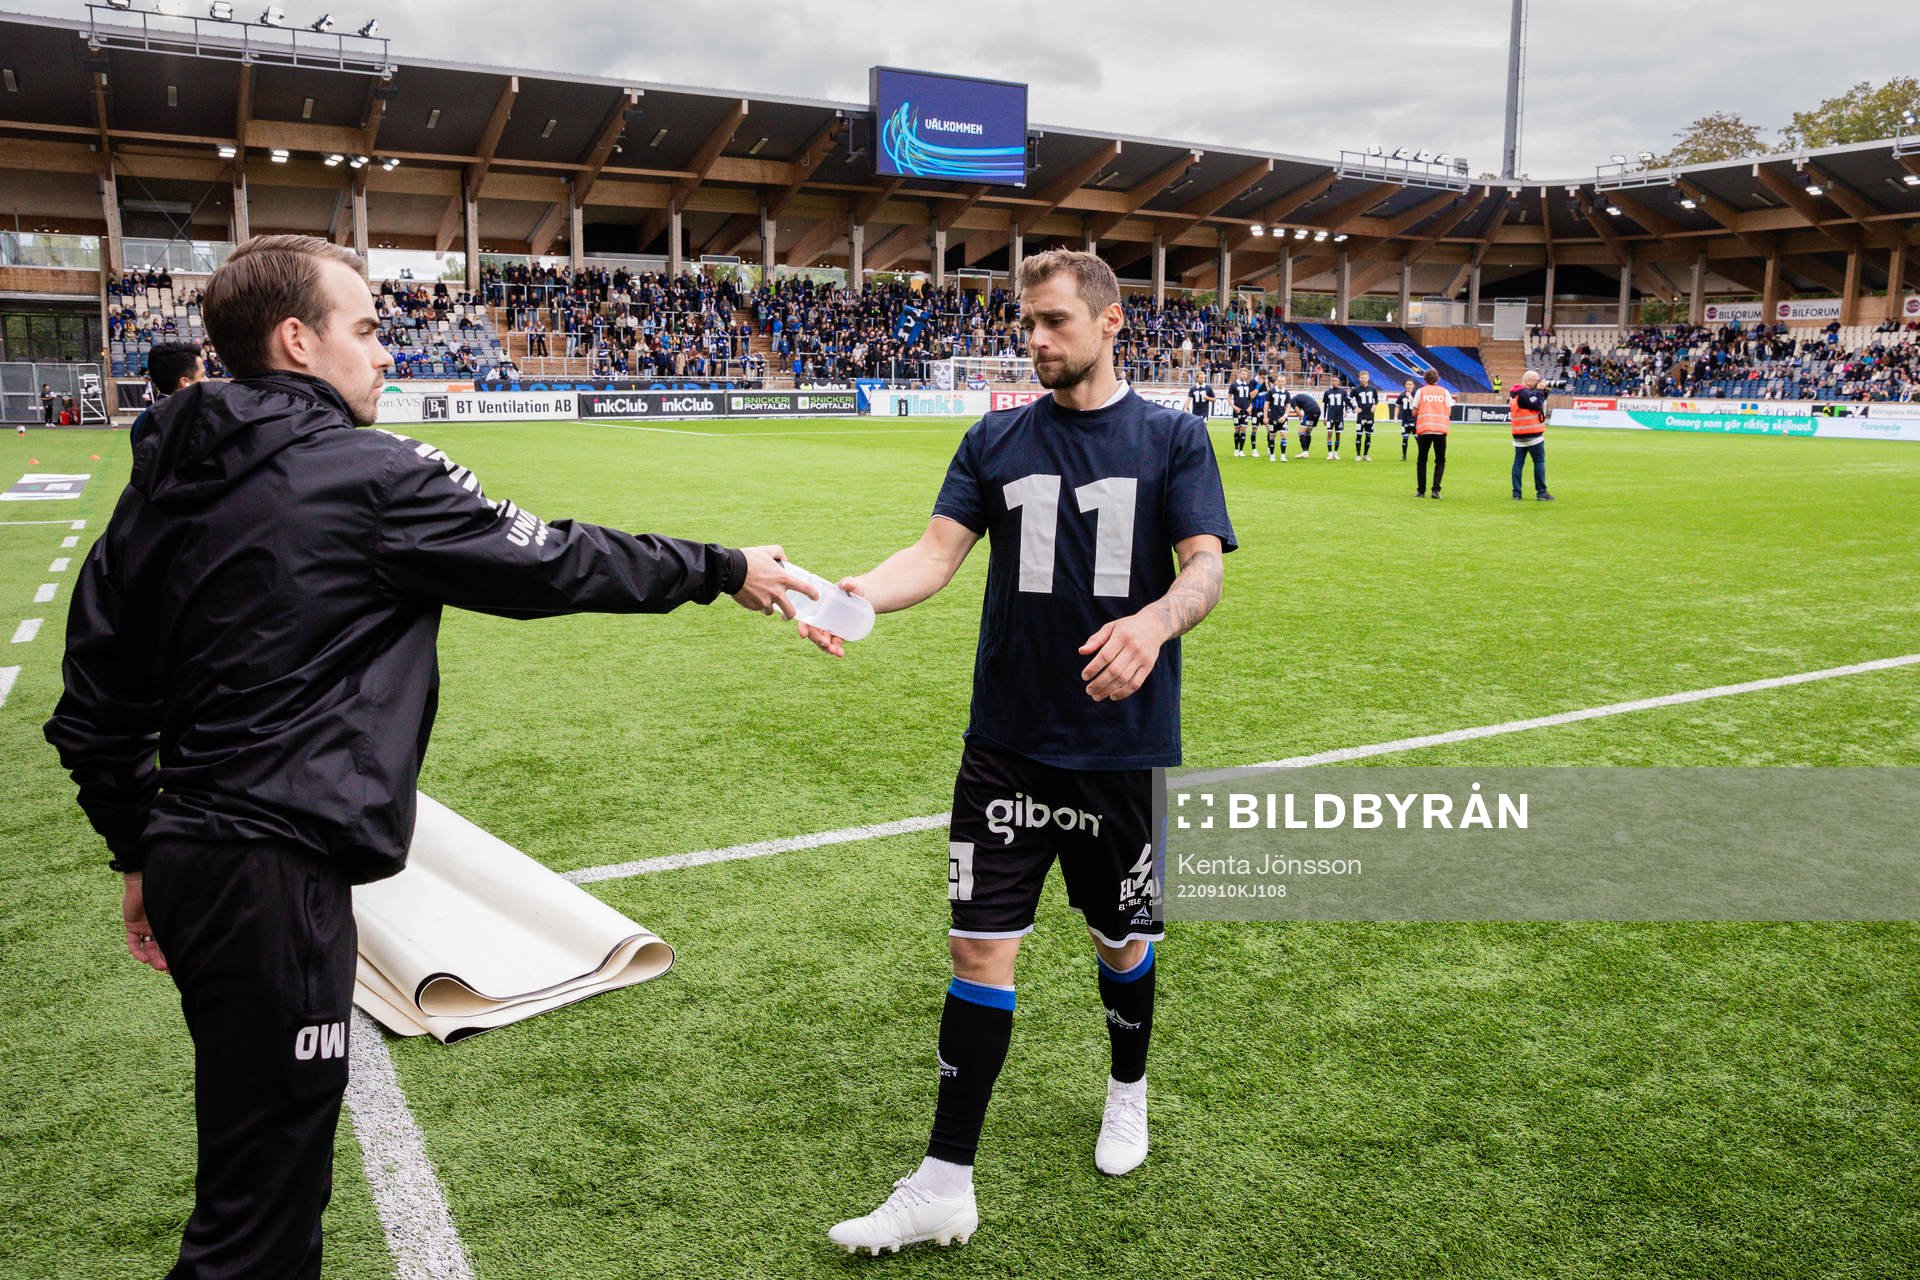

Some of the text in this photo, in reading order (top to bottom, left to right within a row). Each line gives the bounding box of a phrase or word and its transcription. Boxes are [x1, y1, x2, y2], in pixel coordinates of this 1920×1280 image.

[924, 117, 983, 135] VÄLKOMMEN
[1719, 310, 1762, 319] BILFORUM
[1791, 308, 1840, 317] BILFORUM
[1193, 390, 1207, 402] 11
[1237, 386, 1250, 398] 11
[1358, 391, 1374, 404] 11
[593, 398, 648, 413] inkClub
[661, 397, 714, 412] inkClub
[1272, 393, 1286, 406] 11
[1328, 393, 1342, 406] 11
[1423, 395, 1445, 403] FOTO
[456, 399, 572, 414] BT Ventilation AB
[1481, 410, 1508, 422] Railway
[1665, 416, 1700, 429] Omsorg
[1703, 419, 1722, 428] som
[1724, 417, 1741, 431] gör
[1743, 418, 1769, 432] riktig
[1002, 473, 1138, 598] 11
[985, 792, 1099, 845] gibon
[1130, 918, 1153, 926] SELECT
[294, 1022, 345, 1060] OW
